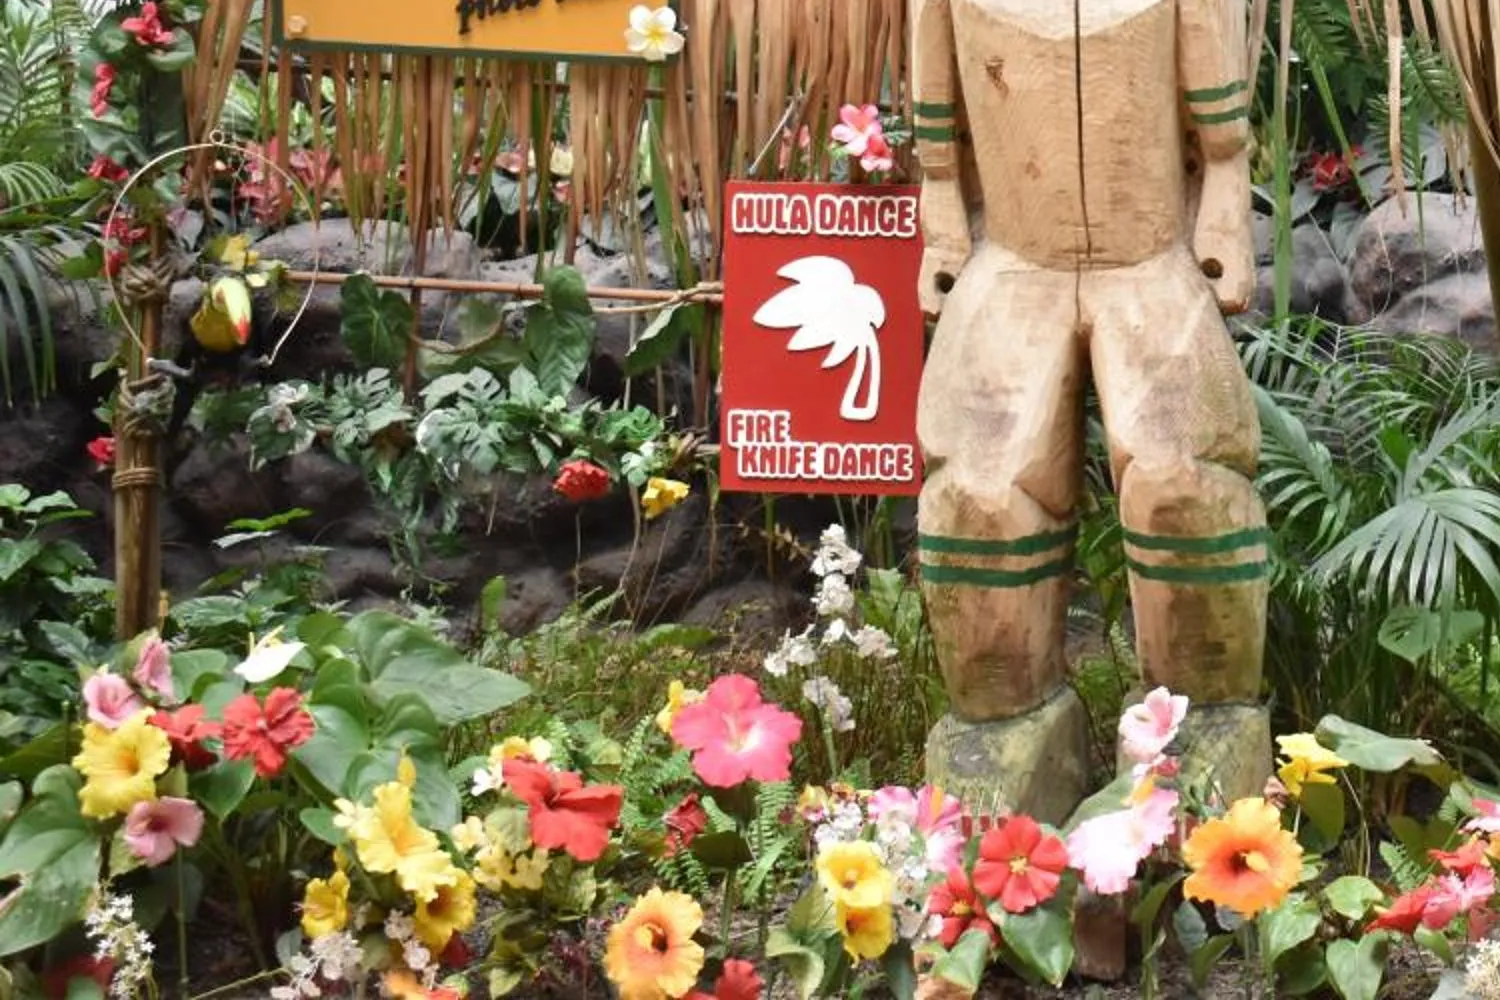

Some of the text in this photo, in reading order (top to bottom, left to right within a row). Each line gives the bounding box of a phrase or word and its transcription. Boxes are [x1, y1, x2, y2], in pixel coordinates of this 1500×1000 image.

[732, 193, 917, 237] HULA DANCE
[727, 409, 791, 446] FIRE
[737, 442, 914, 481] KNIFE DANCE
